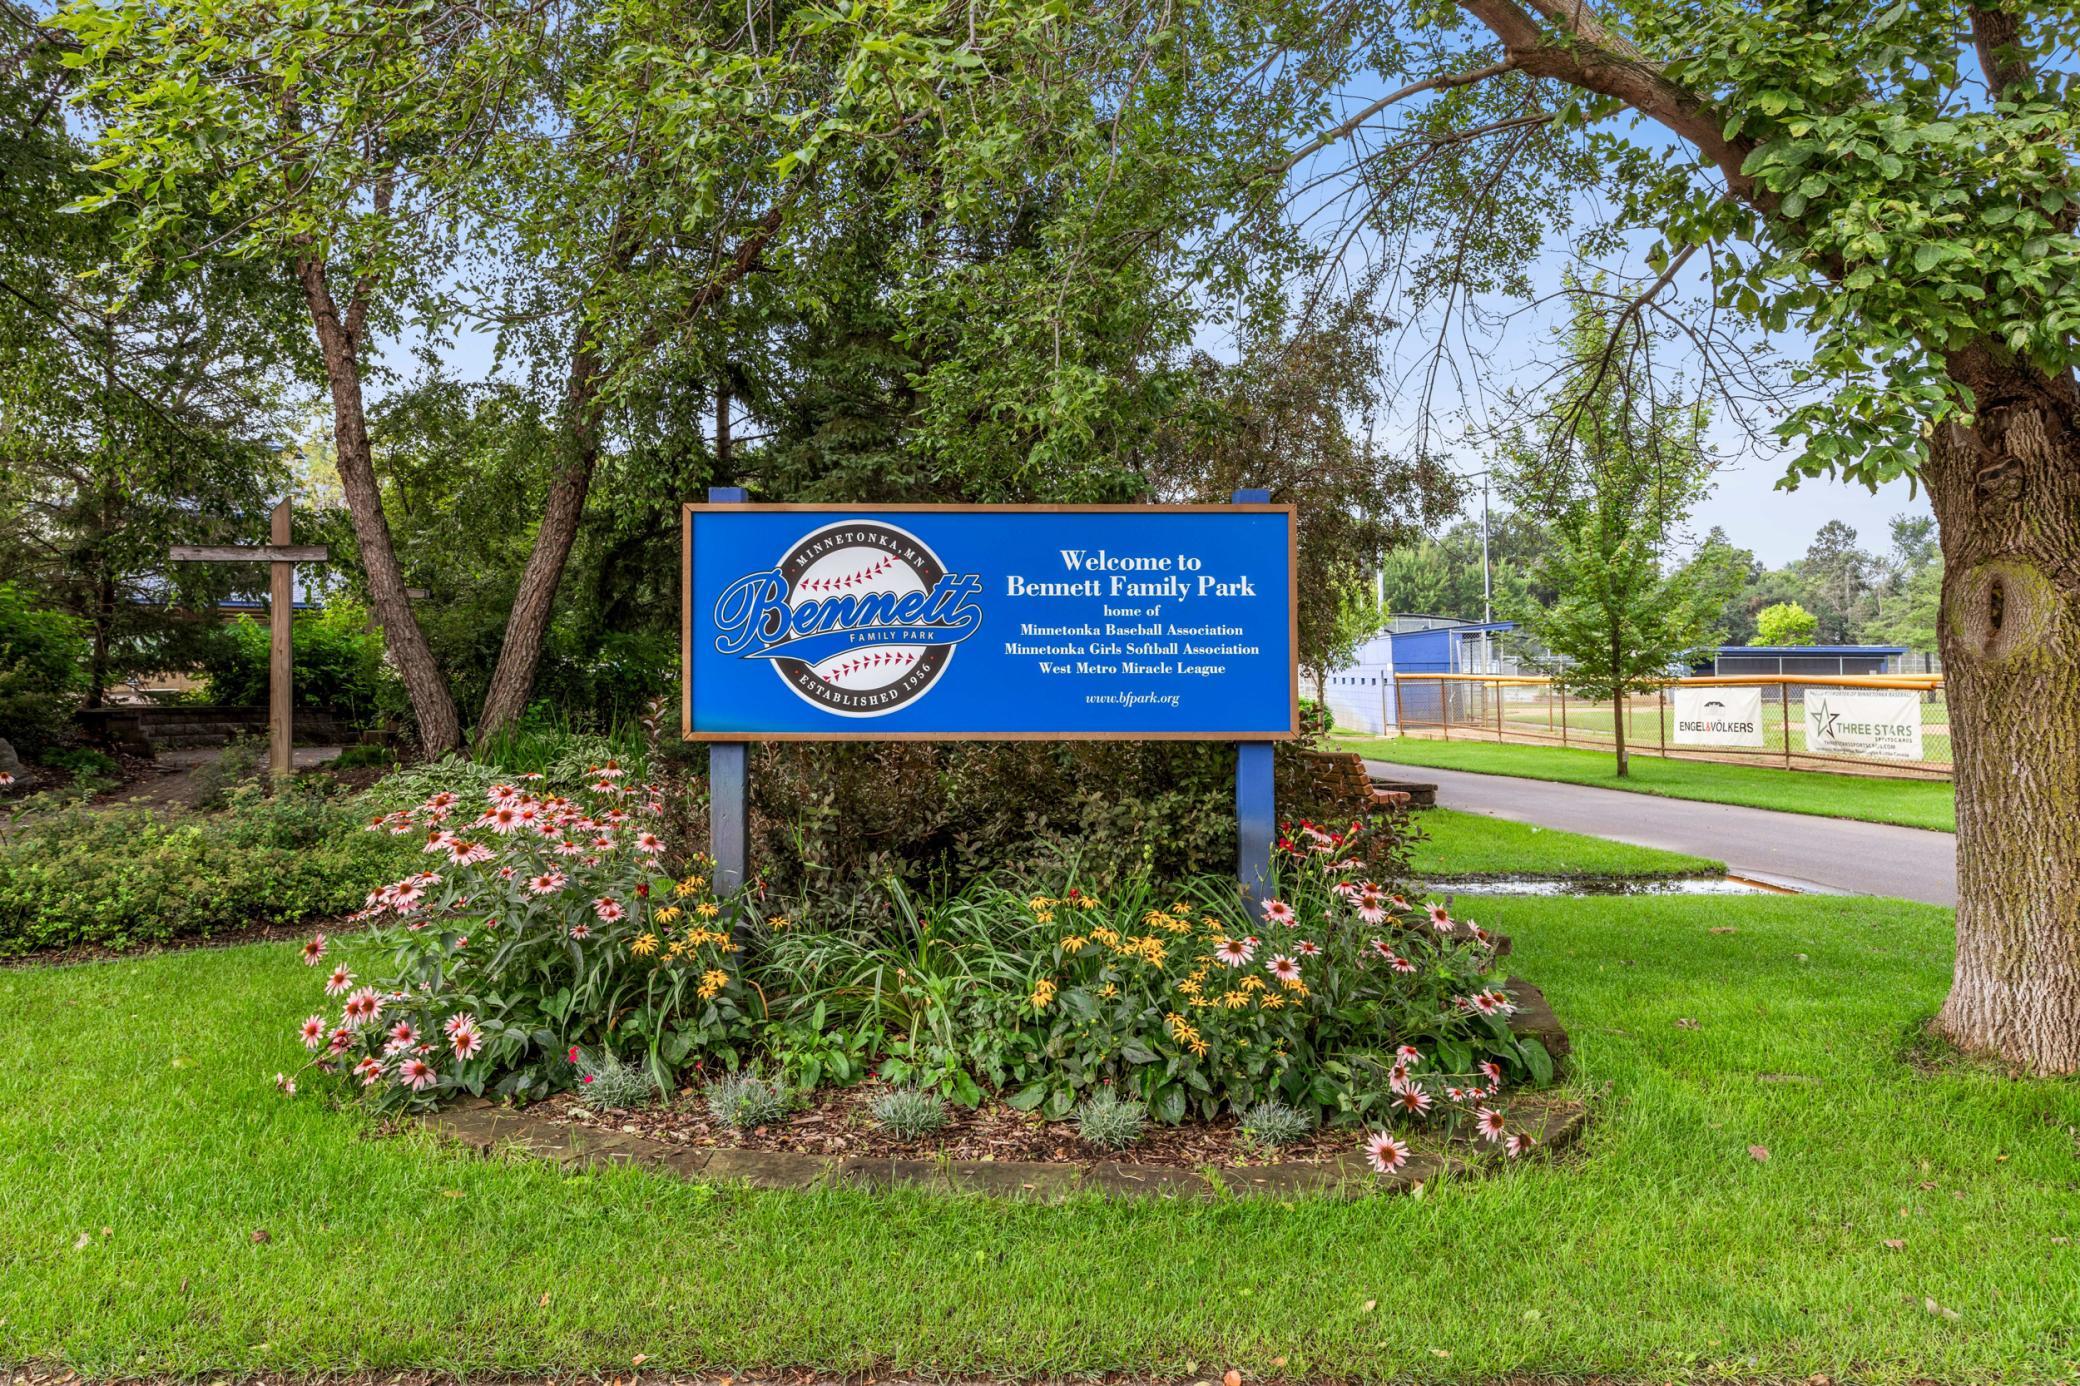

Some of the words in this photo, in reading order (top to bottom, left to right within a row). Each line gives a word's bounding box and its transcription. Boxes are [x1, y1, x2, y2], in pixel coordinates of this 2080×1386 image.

[796, 531, 903, 566] MINNETONKA,
[904, 547, 926, 569] MN
[1060, 550, 1172, 572] Welcome
[1178, 554, 1201, 572] to
[1006, 576, 1102, 597] Bennett
[1109, 576, 1191, 602] Family
[1197, 575, 1256, 597] Park
[714, 567, 984, 654] Bennett
[1103, 605, 1142, 617] home
[1146, 605, 1161, 617] of
[850, 631, 897, 643] FAMILY
[903, 630, 935, 641] PARK
[1020, 624, 1101, 636] Minnetonka
[1105, 624, 1162, 636] Baseball
[1167, 624, 1243, 636] Association
[1004, 643, 1085, 655] Minnetonka
[1089, 643, 1122, 655] Girls
[1126, 643, 1178, 655] Softball
[1183, 643, 1260, 655] Association
[1039, 662, 1072, 674] West
[1076, 662, 1117, 674] Metro
[1121, 662, 1173, 674] Miracle
[1177, 662, 1226, 677] League
[799, 674, 899, 707] ESTABLISHED
[903, 663, 931, 692] 1956
[1086, 691, 1180, 707] www.bfpark.org
[1679, 719, 1754, 733] ENGEL&VÖLKERS
[1836, 722, 1872, 735] THREE
[1874, 724, 1913, 737] STARS
